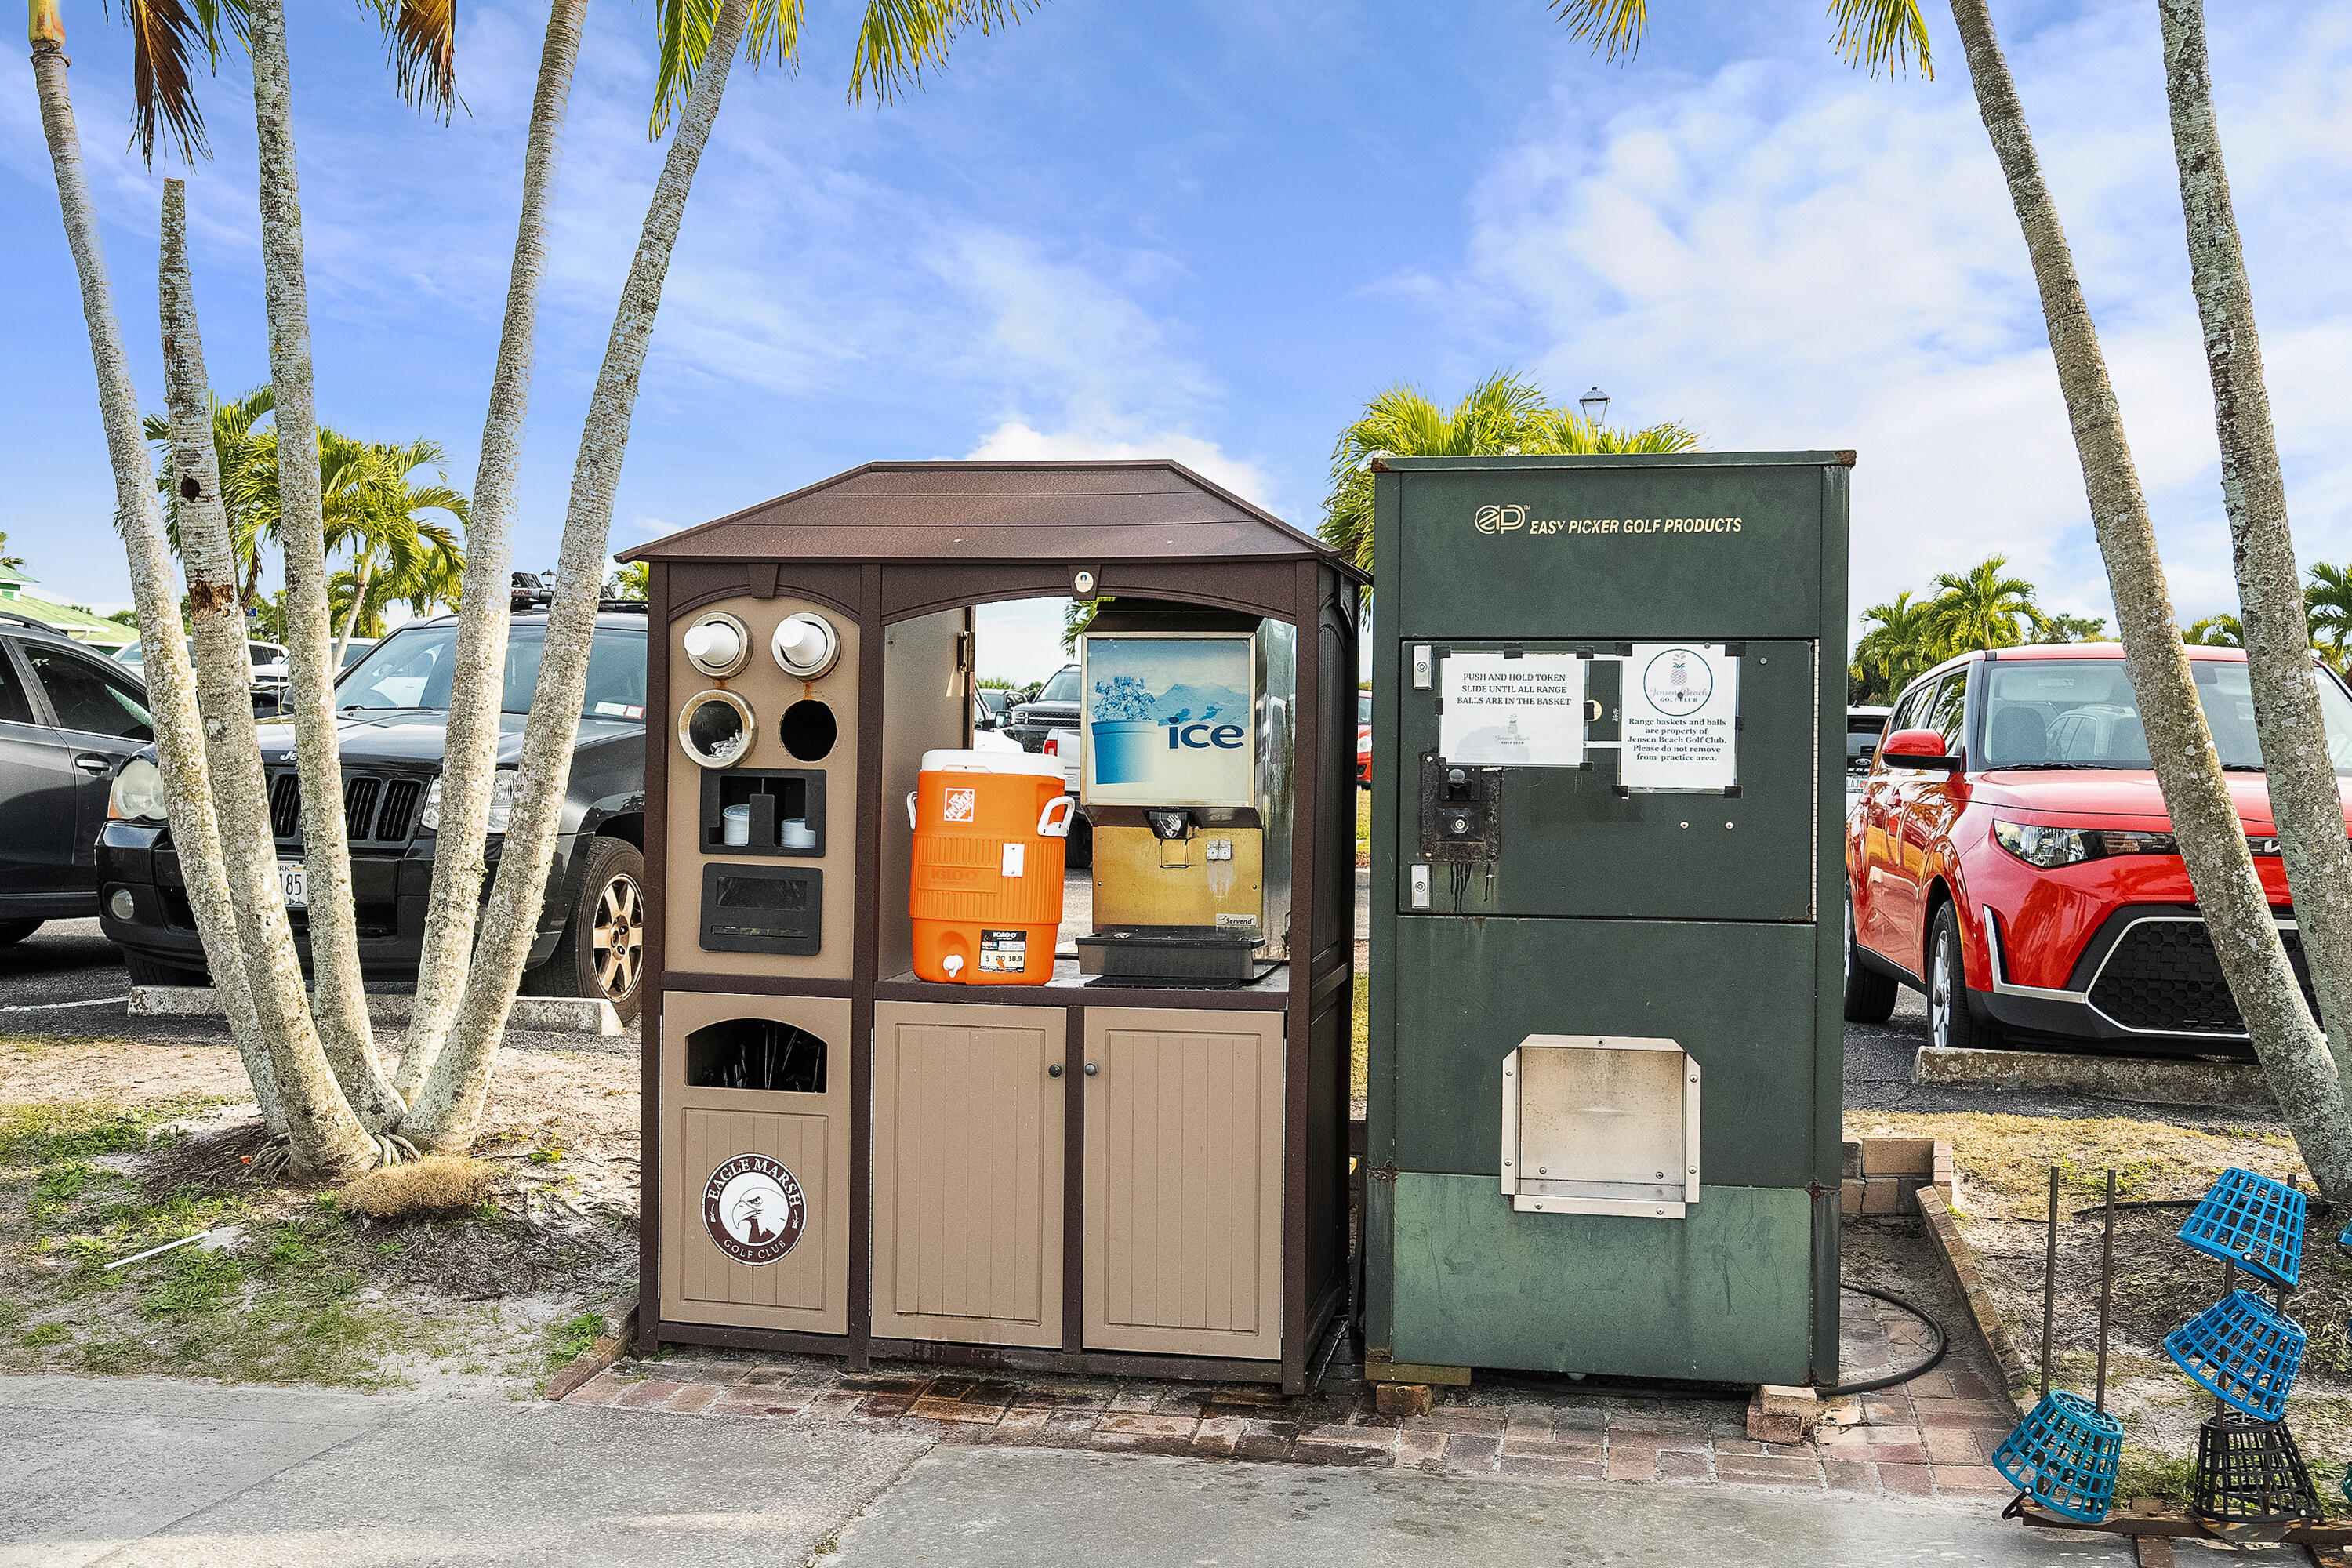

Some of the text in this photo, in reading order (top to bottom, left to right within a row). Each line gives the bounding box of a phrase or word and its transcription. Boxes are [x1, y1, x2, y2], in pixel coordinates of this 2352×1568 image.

[1567, 519, 1620, 534] PICKER
[1622, 518, 1661, 534] GOLF
[1664, 517, 1743, 533] PRODUCTS
[1463, 673, 1486, 681] PUSH
[1168, 717, 1244, 749] ice
[280, 750, 298, 760] Je
[946, 790, 972, 818] HOME
[707, 1158, 802, 1207] EAGLE MARSH
[724, 1239, 786, 1259] GOLF CLUB
